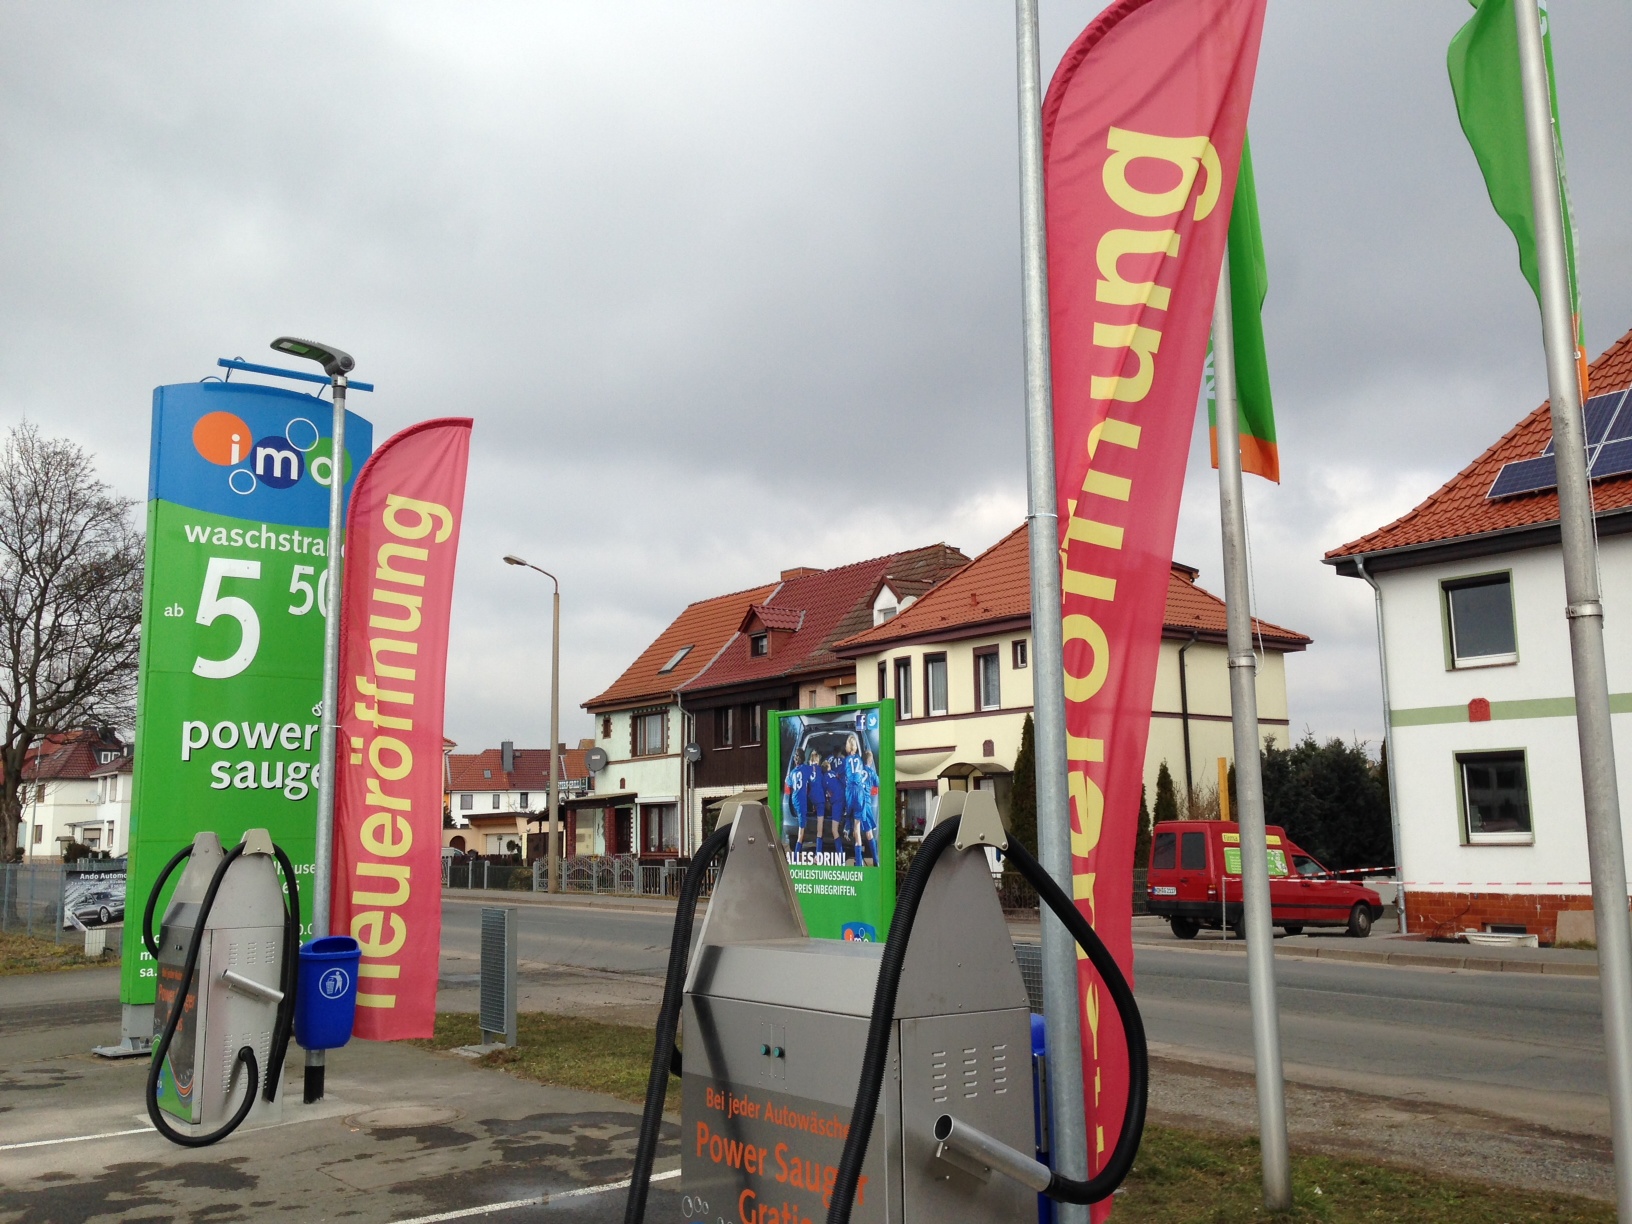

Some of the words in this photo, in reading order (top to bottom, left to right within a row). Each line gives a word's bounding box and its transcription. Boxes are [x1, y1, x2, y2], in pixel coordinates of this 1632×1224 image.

[230, 433, 333, 486] imo
[184, 524, 345, 558] waschstra
[163, 603, 184, 618] ab
[191, 557, 261, 679] 5
[181, 718, 319, 761] power
[349, 493, 454, 1009] neueröffnung
[786, 851, 813, 866] ALLES
[816, 851, 846, 867] DRIN!
[790, 869, 863, 882] OCHLEISTUNGSSAUGEN
[794, 883, 813, 894] PREIS
[813, 884, 857, 897] INBEGRIFFEN.
[139, 967, 158, 979] sa.
[706, 1087, 725, 1111] Bei
[728, 1091, 761, 1119] jeder
[696, 1121, 768, 1176] Power
[774, 1142, 869, 1210] Saugr
[739, 1188, 813, 1224] Grati
